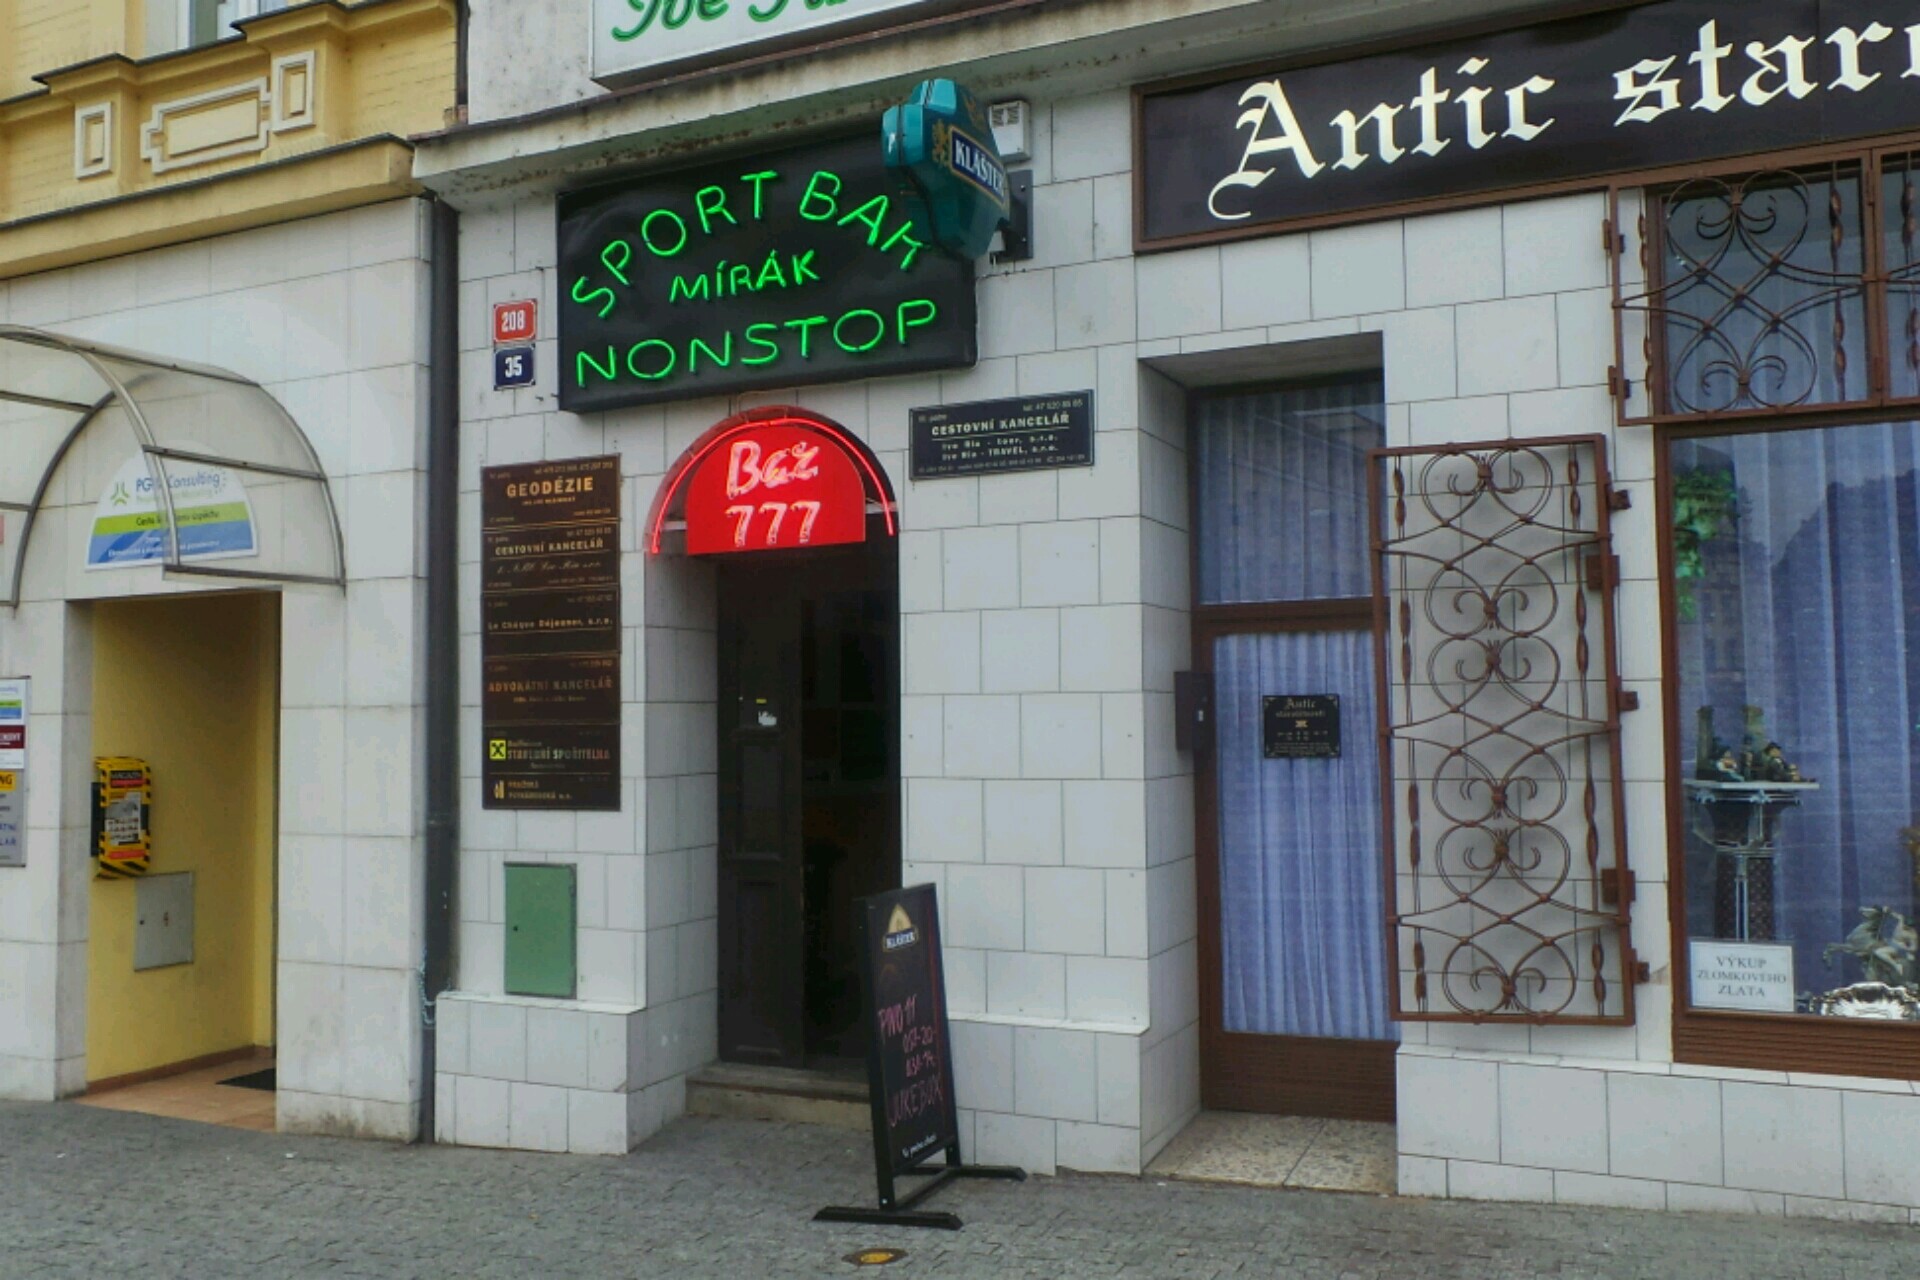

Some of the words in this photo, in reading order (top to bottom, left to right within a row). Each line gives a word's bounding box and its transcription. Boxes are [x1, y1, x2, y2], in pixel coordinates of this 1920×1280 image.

[1207, 57, 1556, 221] Antic
[571, 169, 778, 319] SPORT
[668, 248, 821, 304] MÍRÁK
[501, 310, 526, 332] 208
[575, 298, 938, 388] NONSTOP
[505, 355, 522, 378] 35
[932, 418, 994, 436] CESTOVNÍ
[1000, 411, 1070, 429] KANCELÁŘ
[506, 475, 594, 499] GEODÉZIE
[724, 500, 821, 547] 777
[495, 541, 544, 556] CESTOVNÍ
[549, 537, 604, 553] KANCELÁŘ
[488, 679, 549, 693] ADVOKÁTNÍ
[553, 676, 613, 690] KANCELÁŘ
[1716, 953, 1767, 969] VÝKUP
[1718, 984, 1765, 997] ZLATA
